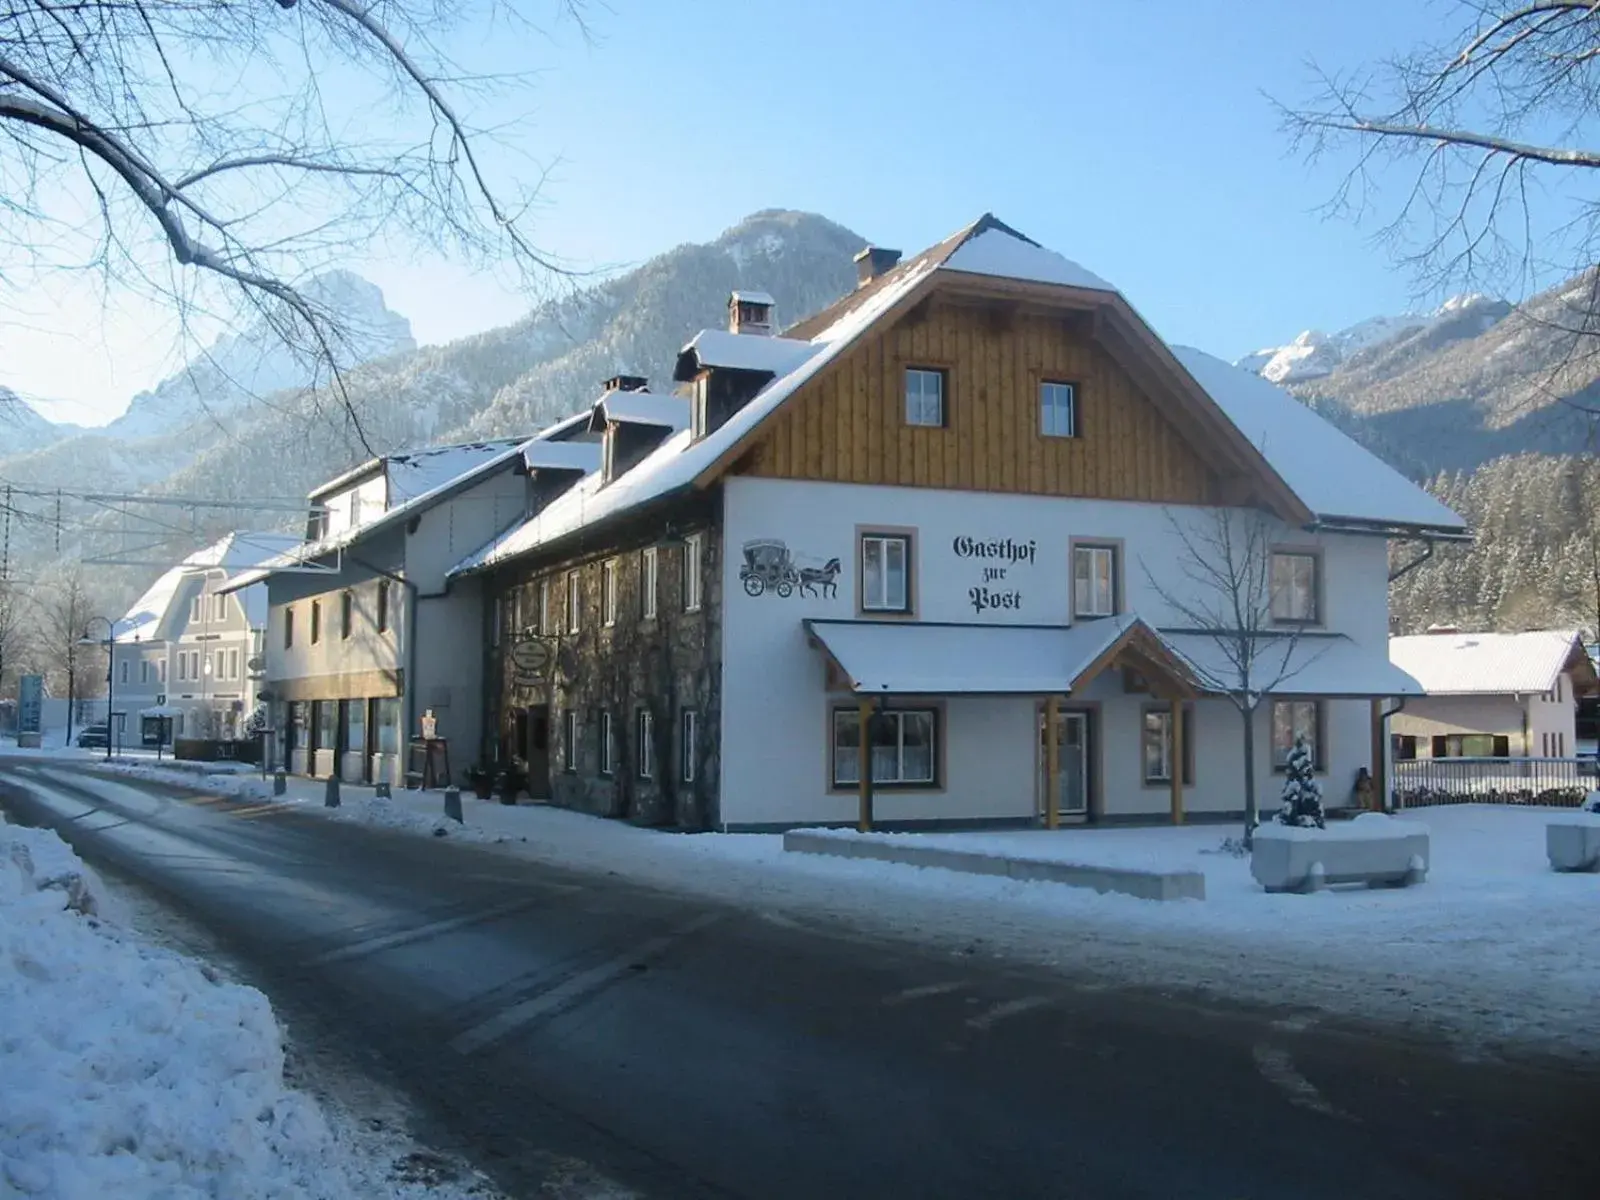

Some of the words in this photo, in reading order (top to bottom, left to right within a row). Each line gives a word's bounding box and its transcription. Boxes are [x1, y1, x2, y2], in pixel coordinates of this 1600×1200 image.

[953, 536, 1036, 565] Gasthof
[983, 567, 1007, 582] zur
[969, 587, 1021, 614] Post
